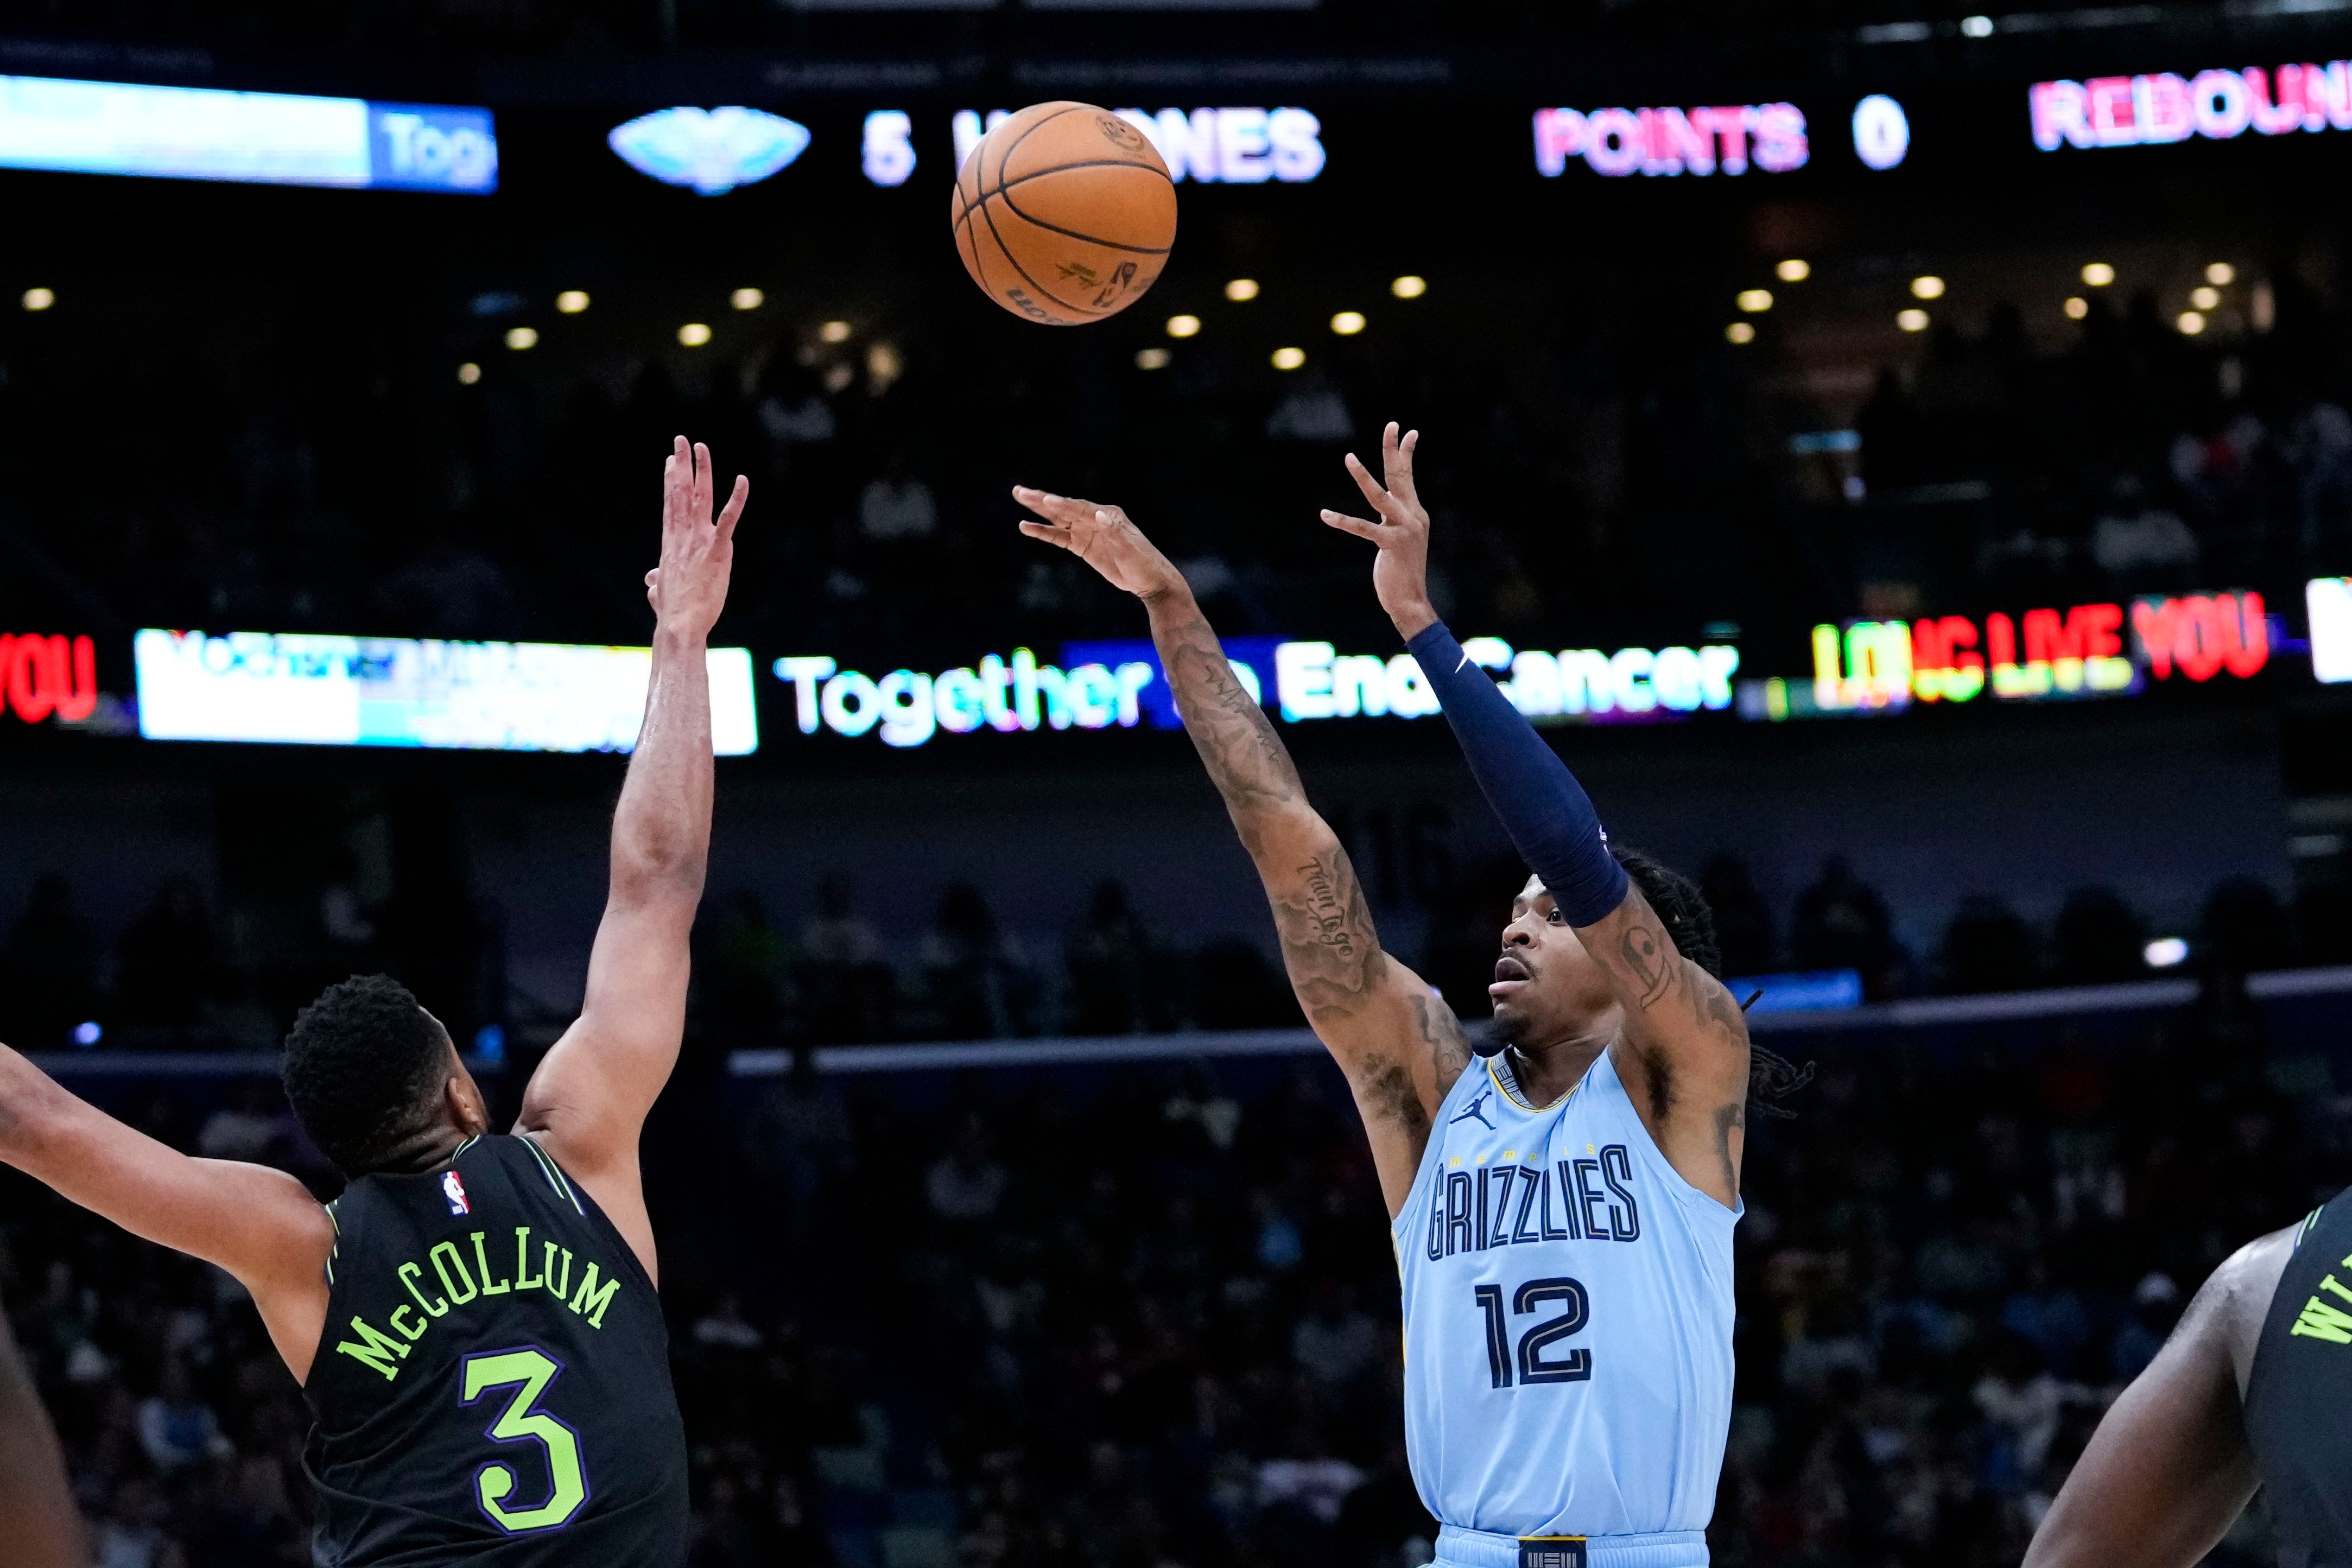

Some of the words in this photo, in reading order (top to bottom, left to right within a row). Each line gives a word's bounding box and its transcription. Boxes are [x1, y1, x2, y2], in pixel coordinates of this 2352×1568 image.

[861, 110, 917, 187] 5
[1532, 102, 1810, 177] POINTS
[1852, 94, 1910, 171] 0
[2028, 61, 2352, 151] REBOUN
[774, 647, 1153, 747] Together
[1987, 603, 2134, 697] LIVE
[2132, 591, 2268, 683] YOU
[1427, 1144, 1640, 1262] GRIZZLIES
[336, 1227, 620, 1381] McCOLLUM
[1475, 1277, 1592, 1389] 12
[459, 1345, 591, 1535] 3
